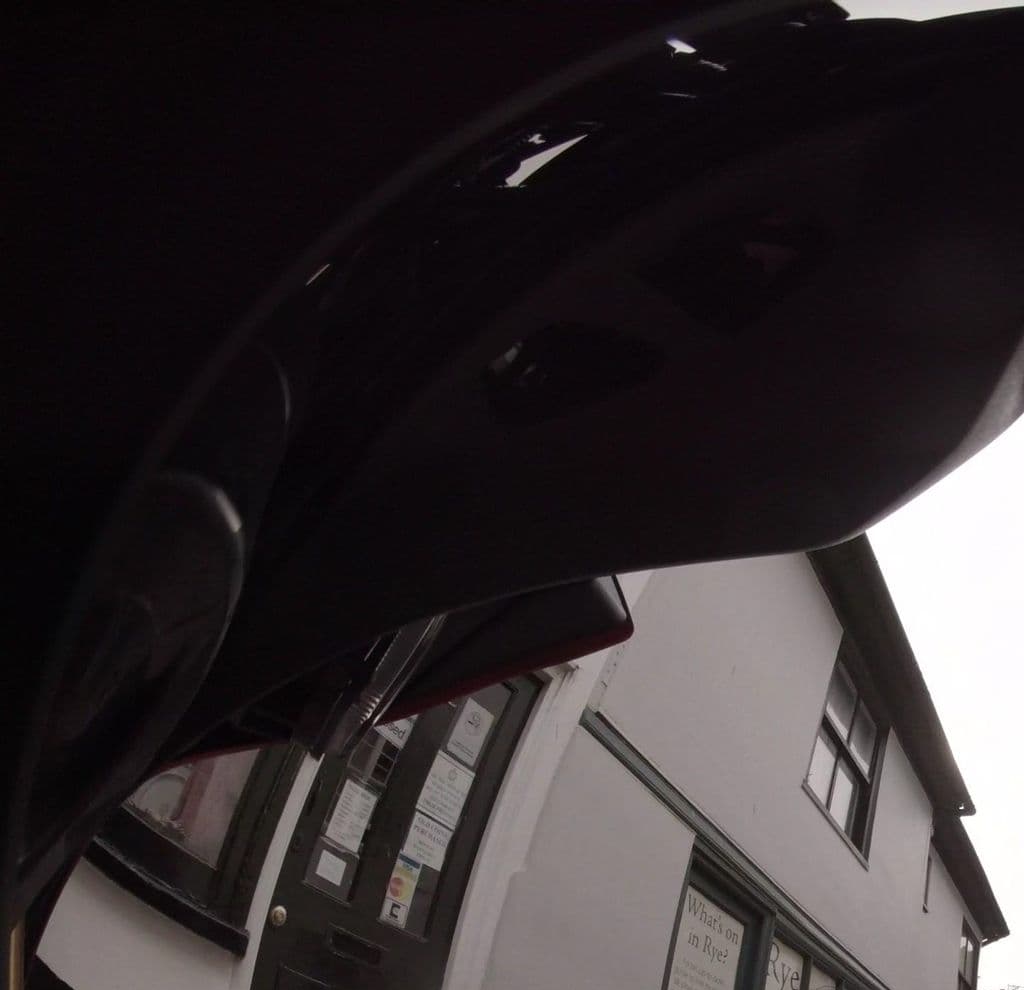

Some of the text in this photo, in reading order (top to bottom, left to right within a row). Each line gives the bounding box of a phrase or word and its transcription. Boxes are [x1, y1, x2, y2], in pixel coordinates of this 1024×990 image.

[687, 893, 739, 945] What's on
[687, 932, 729, 964] in Rye?
